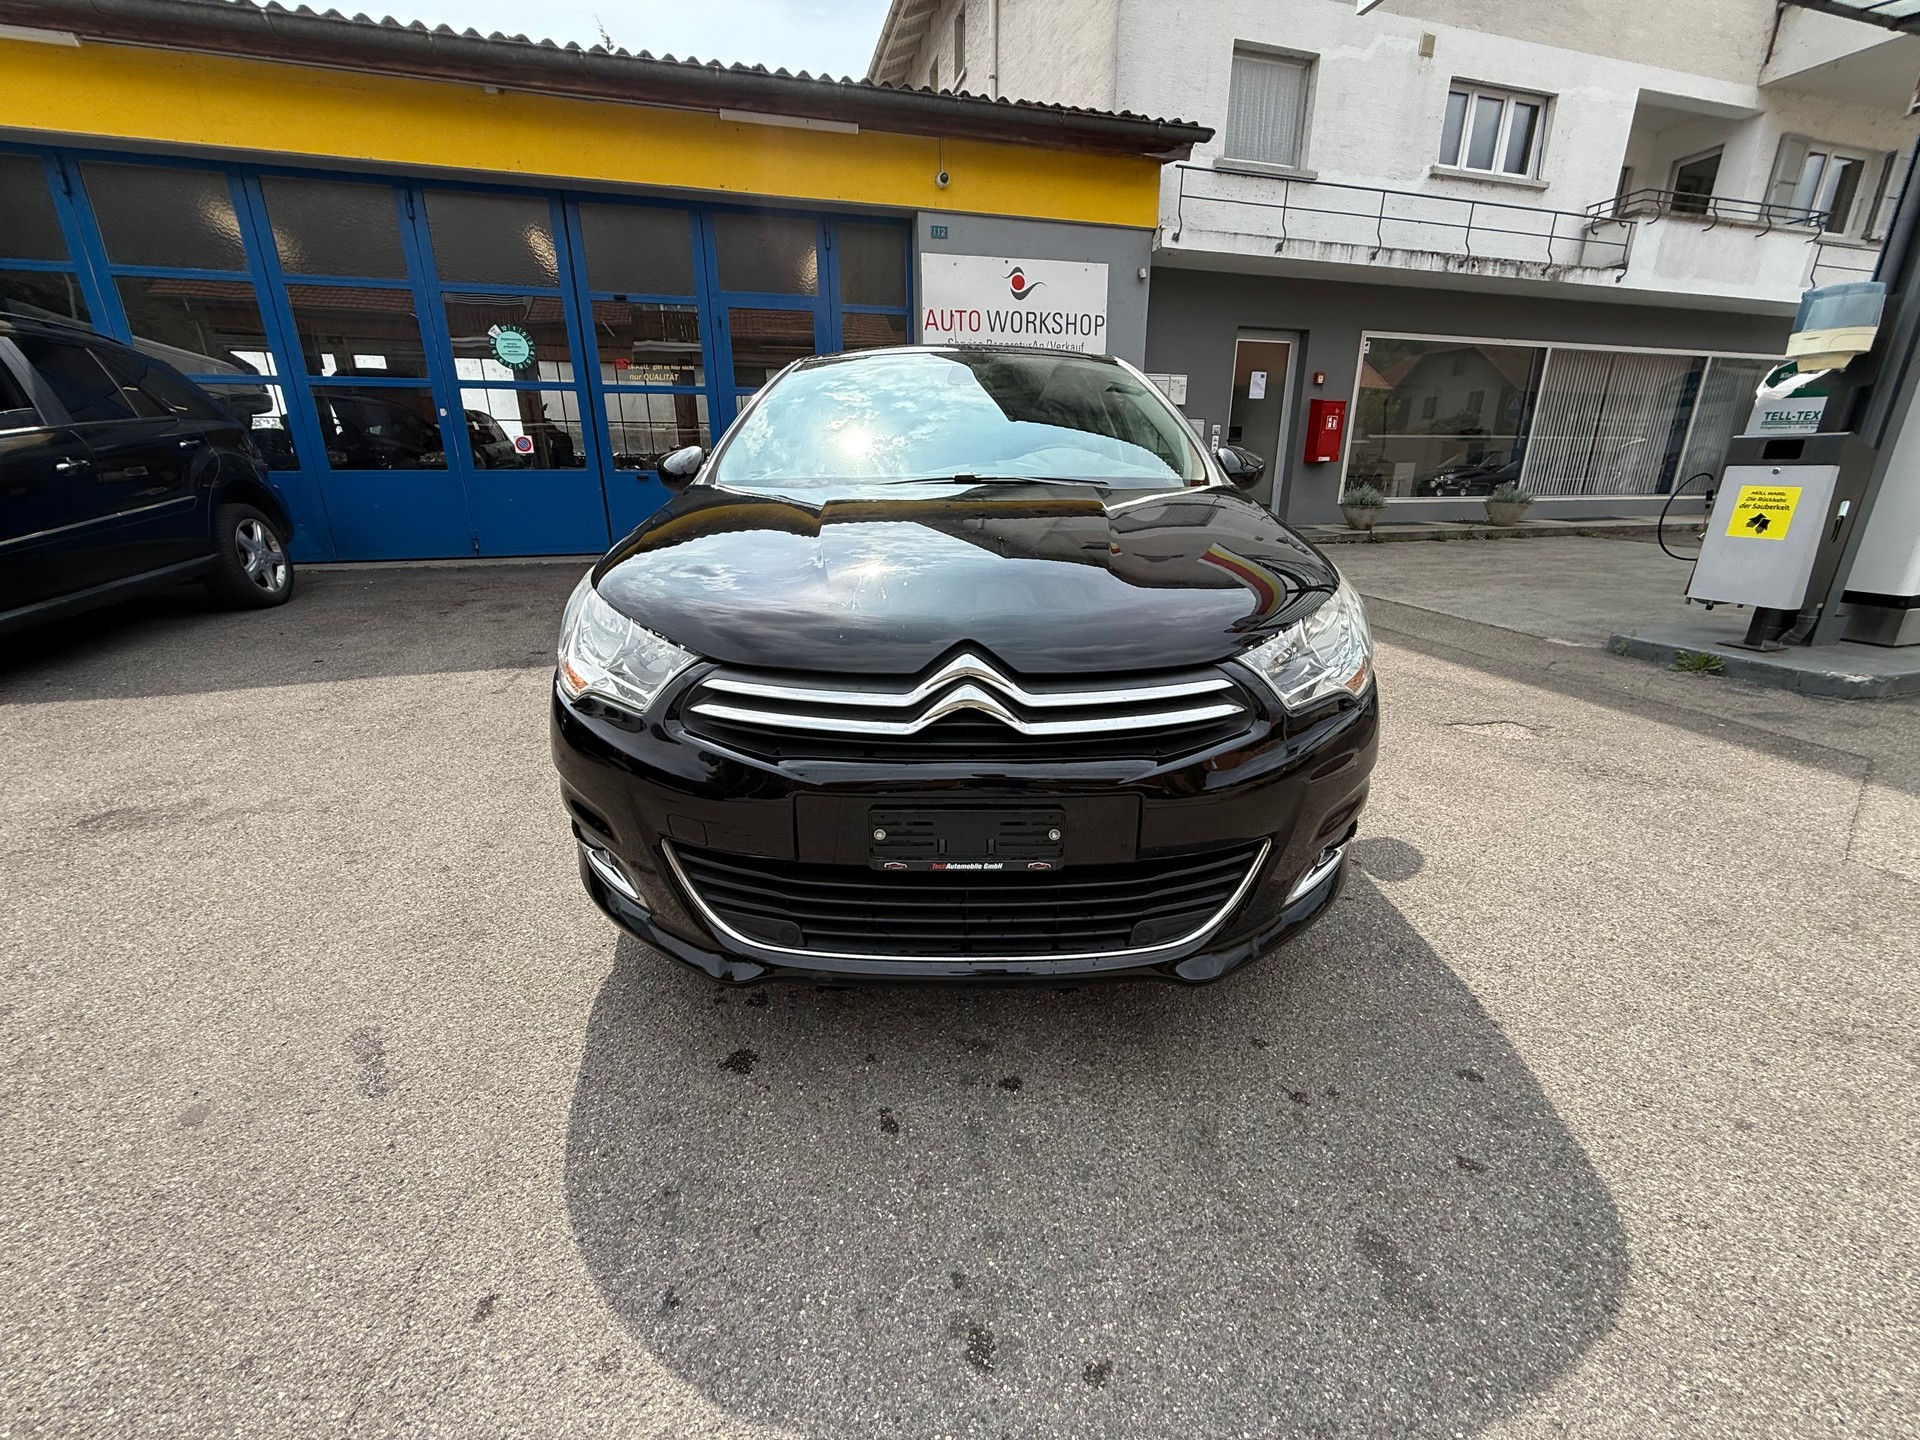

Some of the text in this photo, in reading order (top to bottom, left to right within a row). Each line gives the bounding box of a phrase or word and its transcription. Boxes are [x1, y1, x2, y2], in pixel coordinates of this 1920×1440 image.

[932, 226, 946, 236] 112
[924, 308, 1106, 336] AUTO WORKSHOP
[643, 372, 679, 381] QUALITÄT
[1764, 411, 1821, 420] TELL-TEX
